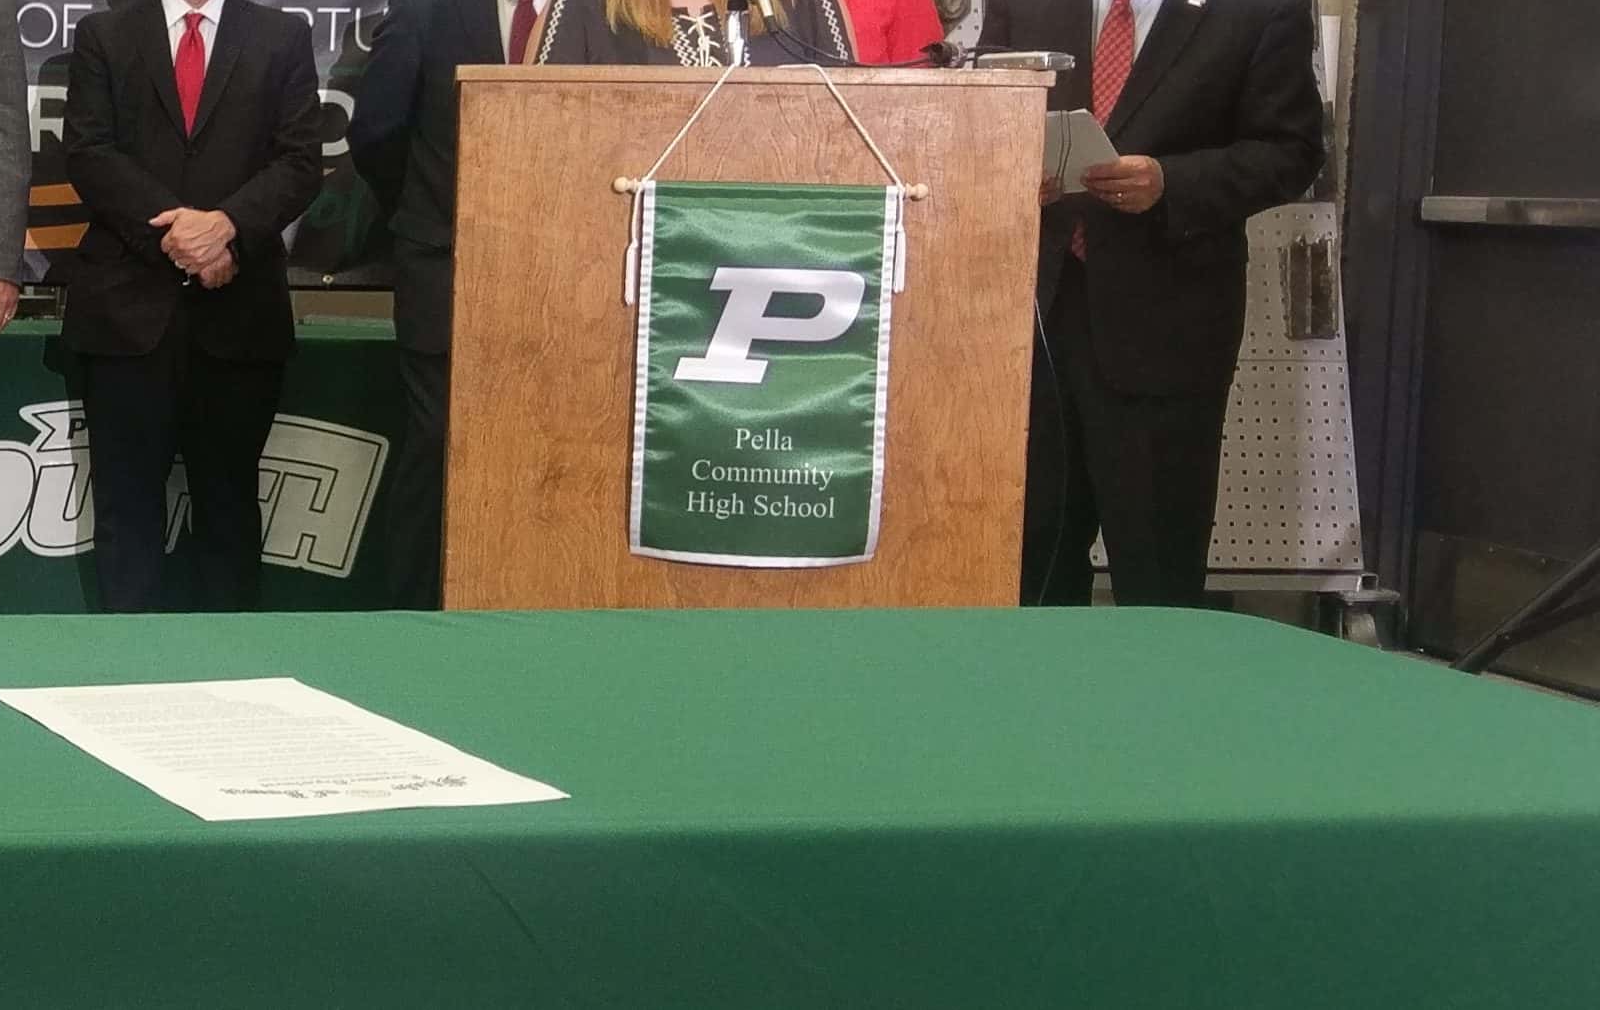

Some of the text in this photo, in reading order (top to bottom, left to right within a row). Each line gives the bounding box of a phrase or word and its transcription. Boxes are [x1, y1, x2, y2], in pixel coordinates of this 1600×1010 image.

[672, 267, 866, 384] P
[735, 428, 793, 450] Pella
[691, 458, 835, 489] Community
[686, 491, 835, 519] High School
